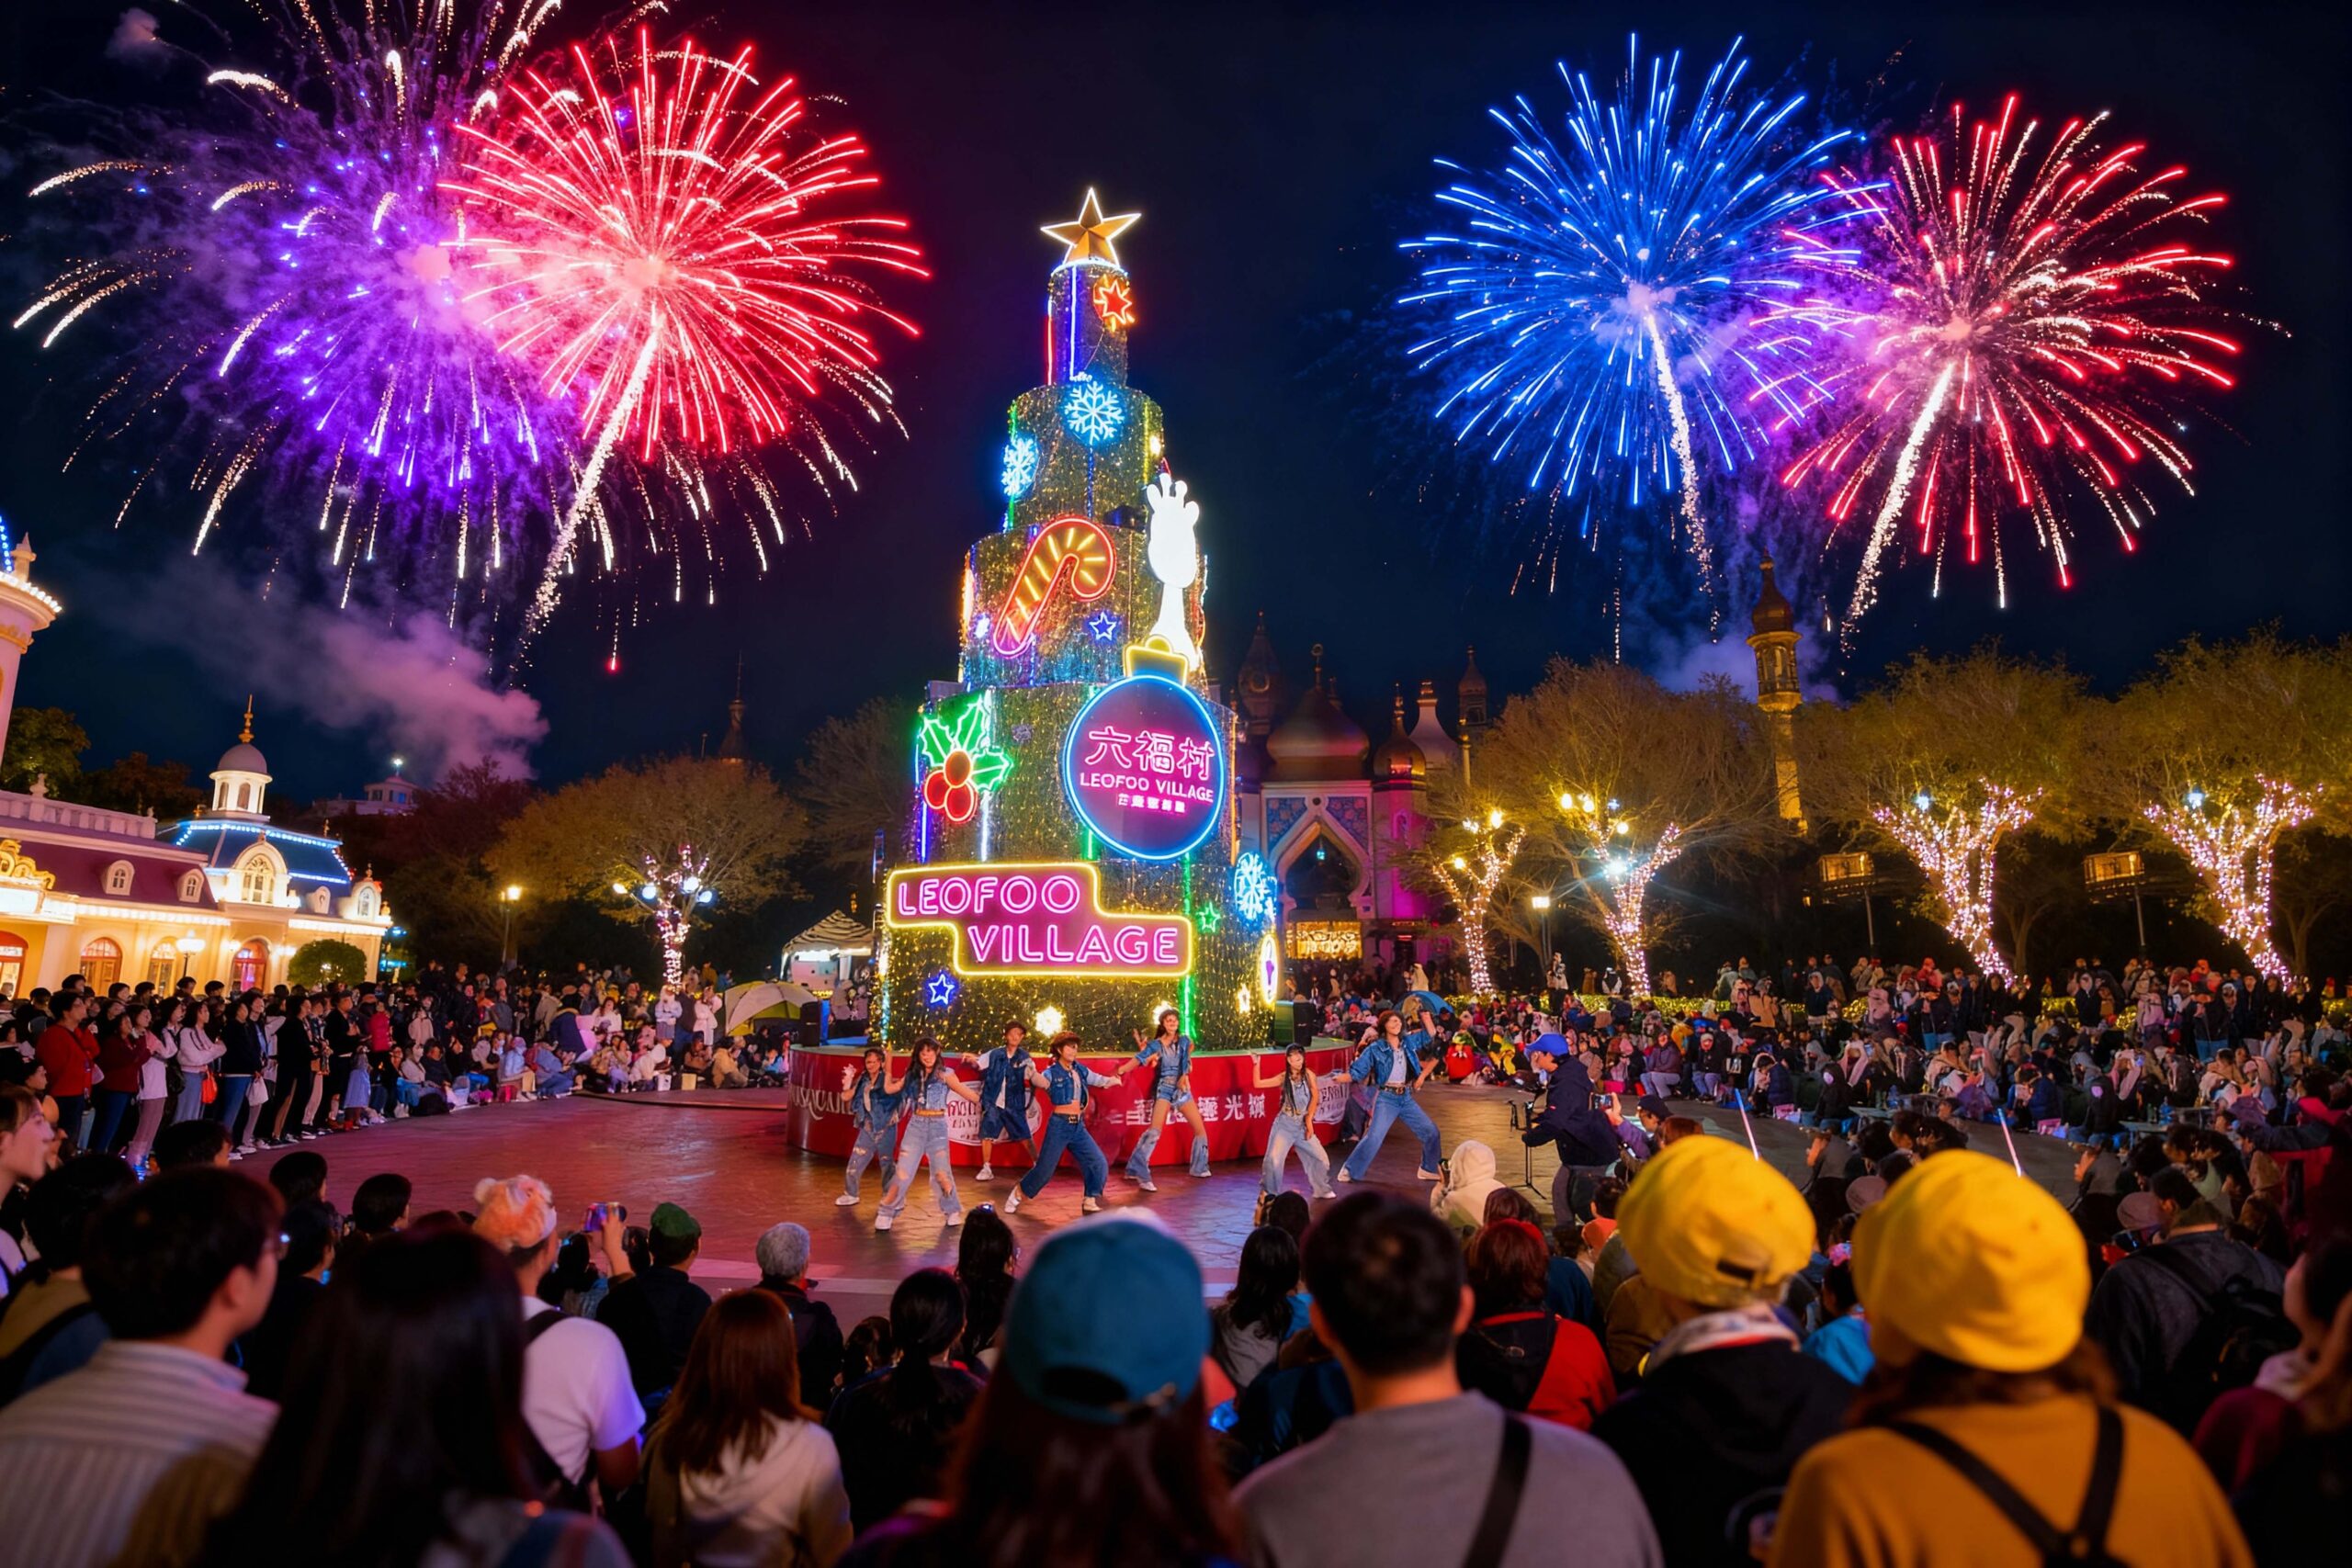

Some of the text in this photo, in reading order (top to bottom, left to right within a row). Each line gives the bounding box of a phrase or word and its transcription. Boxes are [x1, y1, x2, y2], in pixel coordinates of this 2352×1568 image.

[1085, 726, 1216, 781] 六福村
[1080, 772, 1149, 791] LEOFOO
[1155, 779, 1214, 803] VILLAGE
[898, 874, 1080, 916] LEOFOO
[967, 924, 1180, 964] VILLAGE
